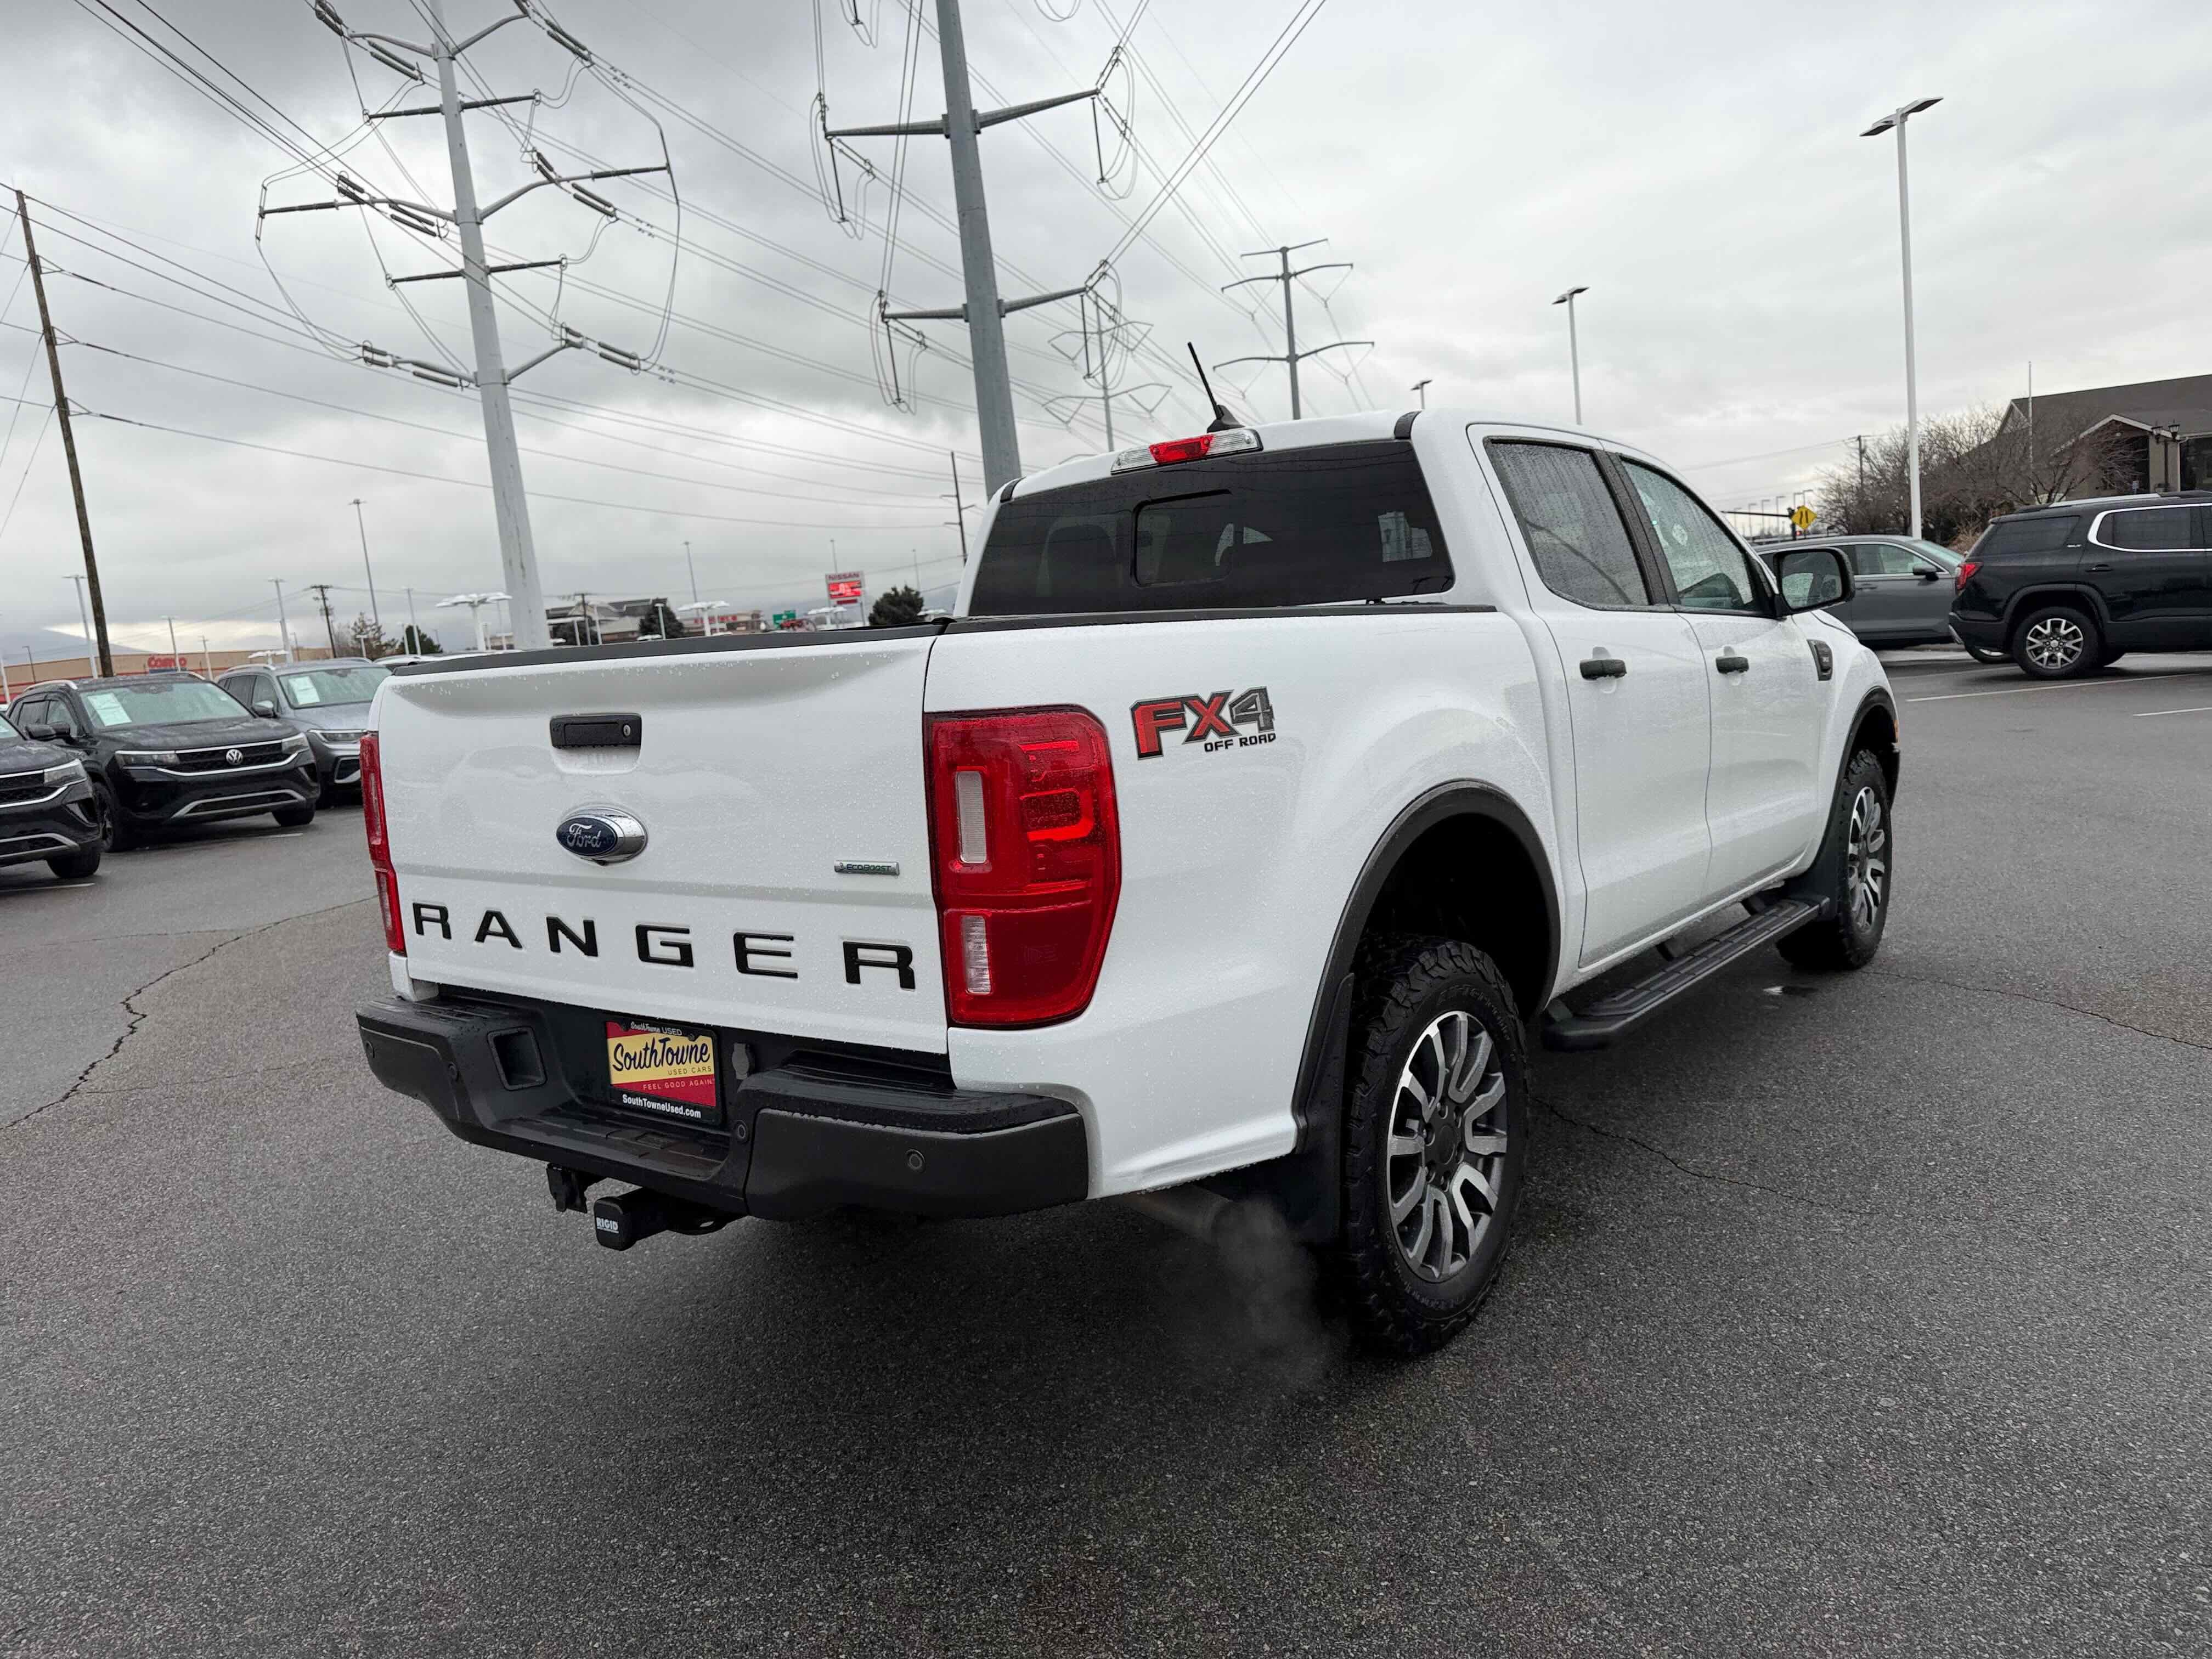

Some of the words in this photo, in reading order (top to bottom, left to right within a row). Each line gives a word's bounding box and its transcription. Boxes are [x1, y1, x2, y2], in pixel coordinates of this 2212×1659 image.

[1130, 686, 1274, 760] FX4
[1204, 738, 1234, 752] OFF
[1239, 733, 1277, 747] ROAD
[567, 823, 603, 848] Ford
[413, 902, 916, 990] RANGER
[662, 1026, 682, 1036] USED
[612, 1037, 710, 1071] SouthTowne
[622, 1093, 701, 1119] SouthTowneUsed.com
[596, 1217, 619, 1231] RIGID
